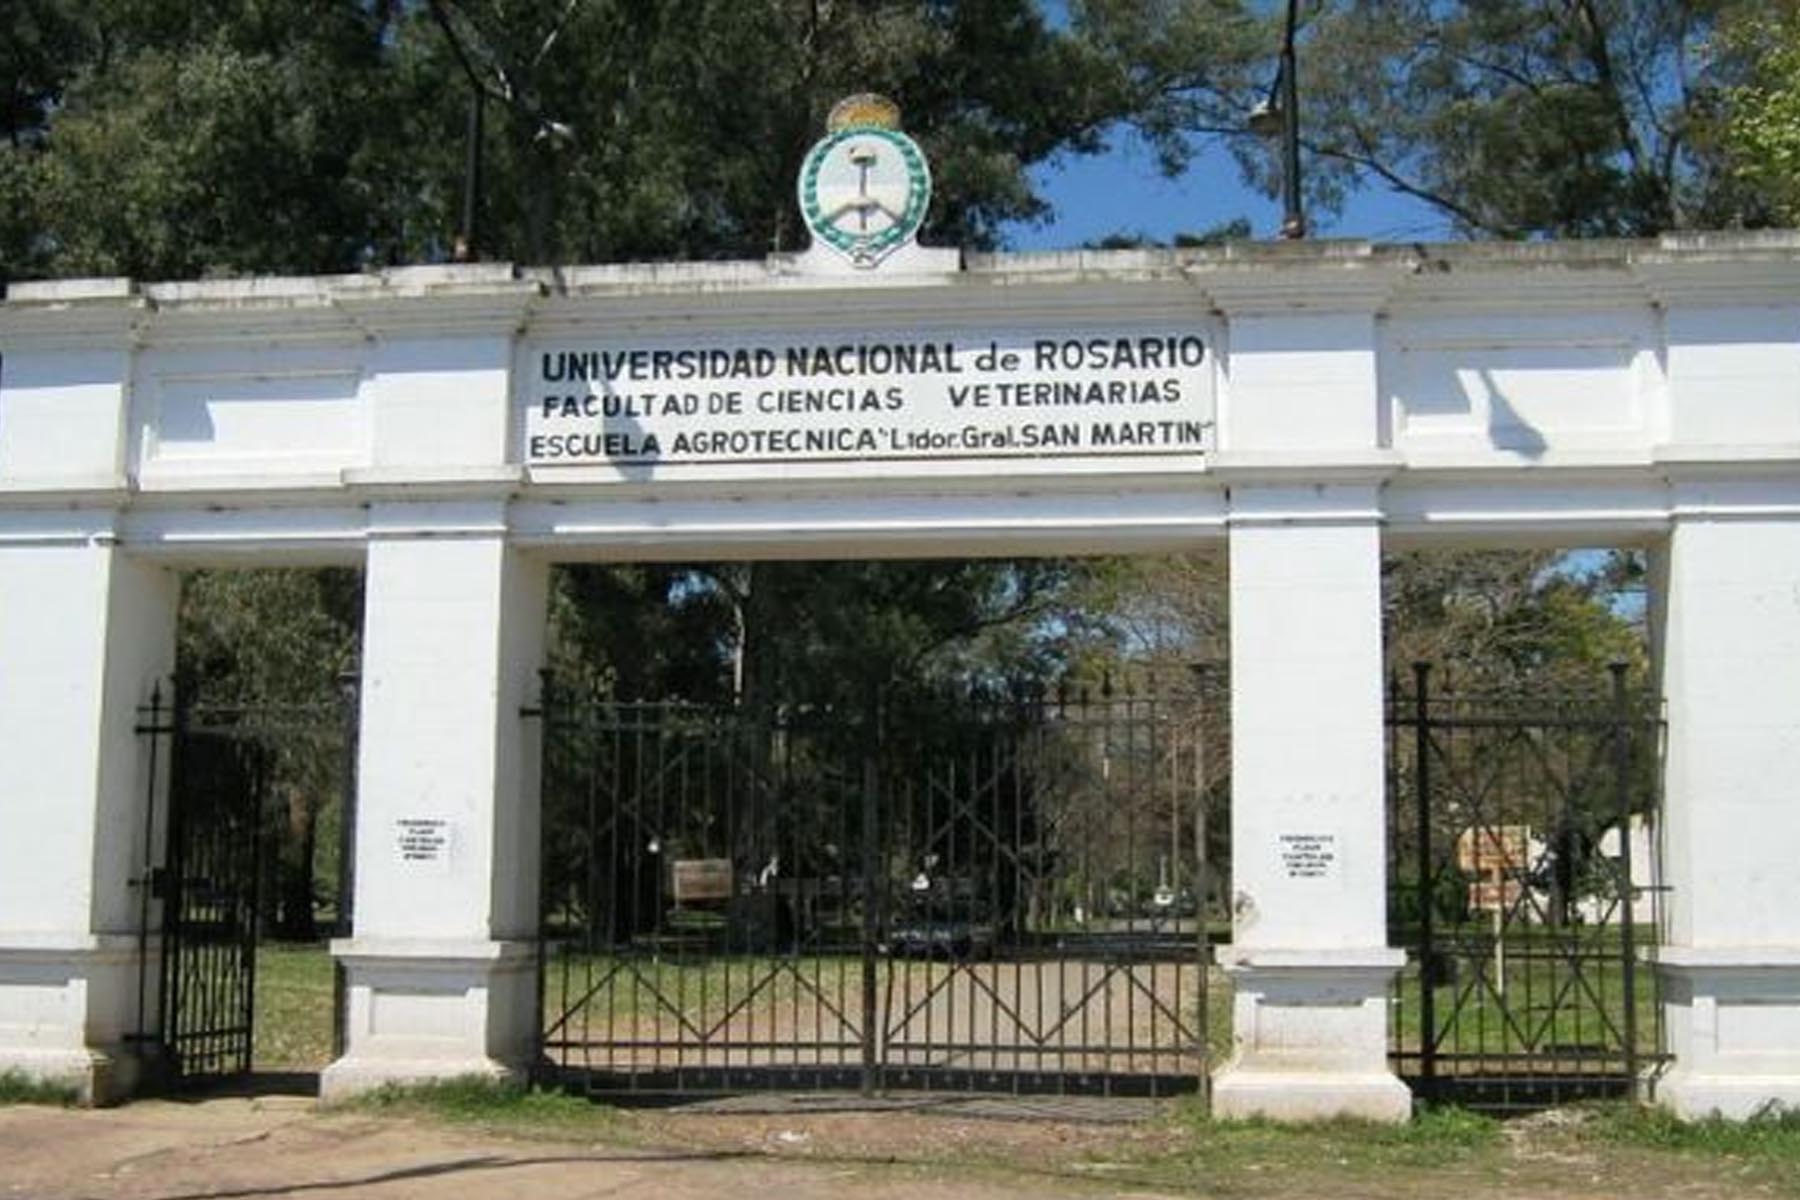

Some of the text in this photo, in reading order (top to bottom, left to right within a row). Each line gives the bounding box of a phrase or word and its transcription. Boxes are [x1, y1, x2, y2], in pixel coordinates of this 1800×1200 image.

[542, 335, 1204, 382] UNIVERSIDAD NACIONAL de ROSARIO
[542, 379, 1181, 418] FACULTAD DE CIENCIAS VETERINARIAS
[530, 433, 660, 458] ESCUELA
[671, 426, 878, 454] AGROTECNICA
